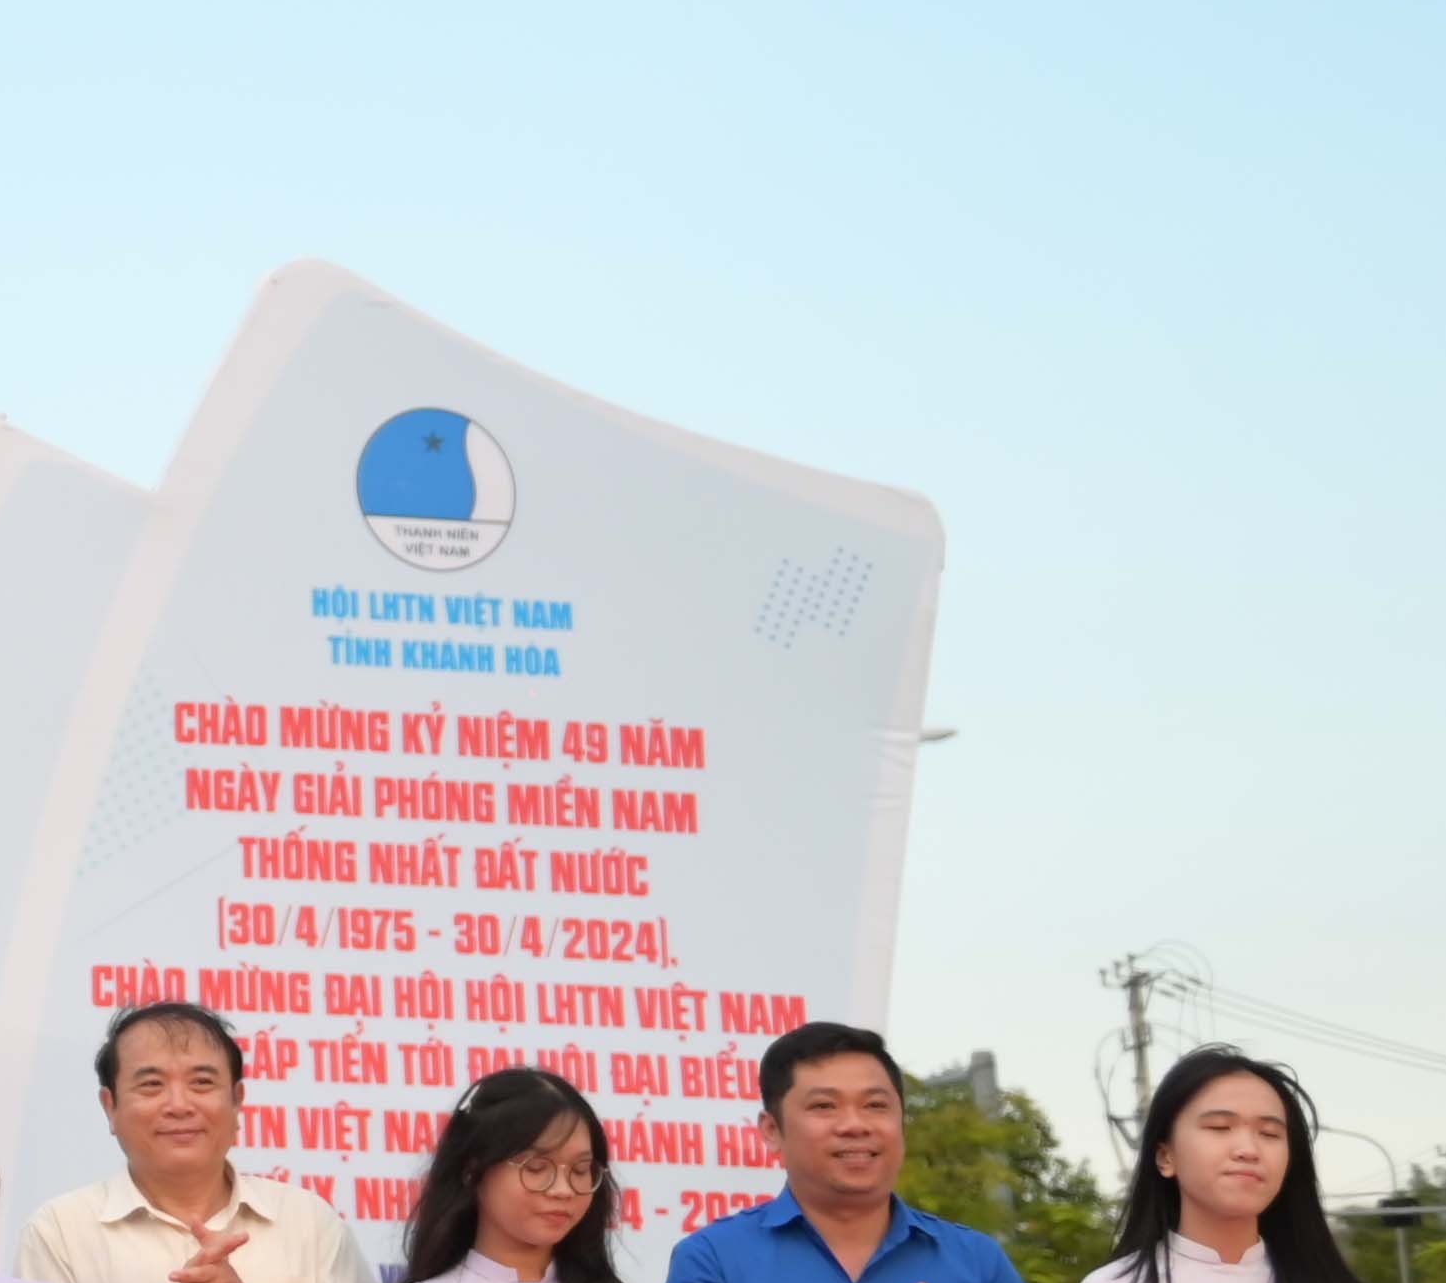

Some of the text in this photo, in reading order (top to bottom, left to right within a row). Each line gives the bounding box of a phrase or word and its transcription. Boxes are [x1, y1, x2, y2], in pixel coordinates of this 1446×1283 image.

[440, 544, 470, 558] NAM
[311, 584, 574, 632] HỘI LHTN VIỆT NAM
[174, 696, 706, 770] CHÀO MỪNG KỶ NIỆM 49 NĂM
[185, 763, 282, 813] NGÀY
[292, 760, 362, 817] GIẢI
[374, 772, 495, 824] PHÓNG
[611, 789, 699, 834] NAM
[238, 825, 650, 897] THỐNG NHẤT ĐẤT NƯỚC
[91, 958, 187, 1008] CHÀO
[199, 960, 311, 1014] MỪNG
[394, 970, 454, 1031] HỘI
[465, 973, 526, 1033] HỘI
[537, 983, 626, 1028] LHTN
[634, 981, 708, 1042] VIỆT
[719, 991, 807, 1037] NAM
[398, 1036, 456, 1087] TỚI
[611, 1051, 671, 1106] ĐẠI
[680, 1041, 761, 1101] BIỂU
[297, 1100, 372, 1163] VIỆT
[603, 1112, 706, 1166] HÁNH
